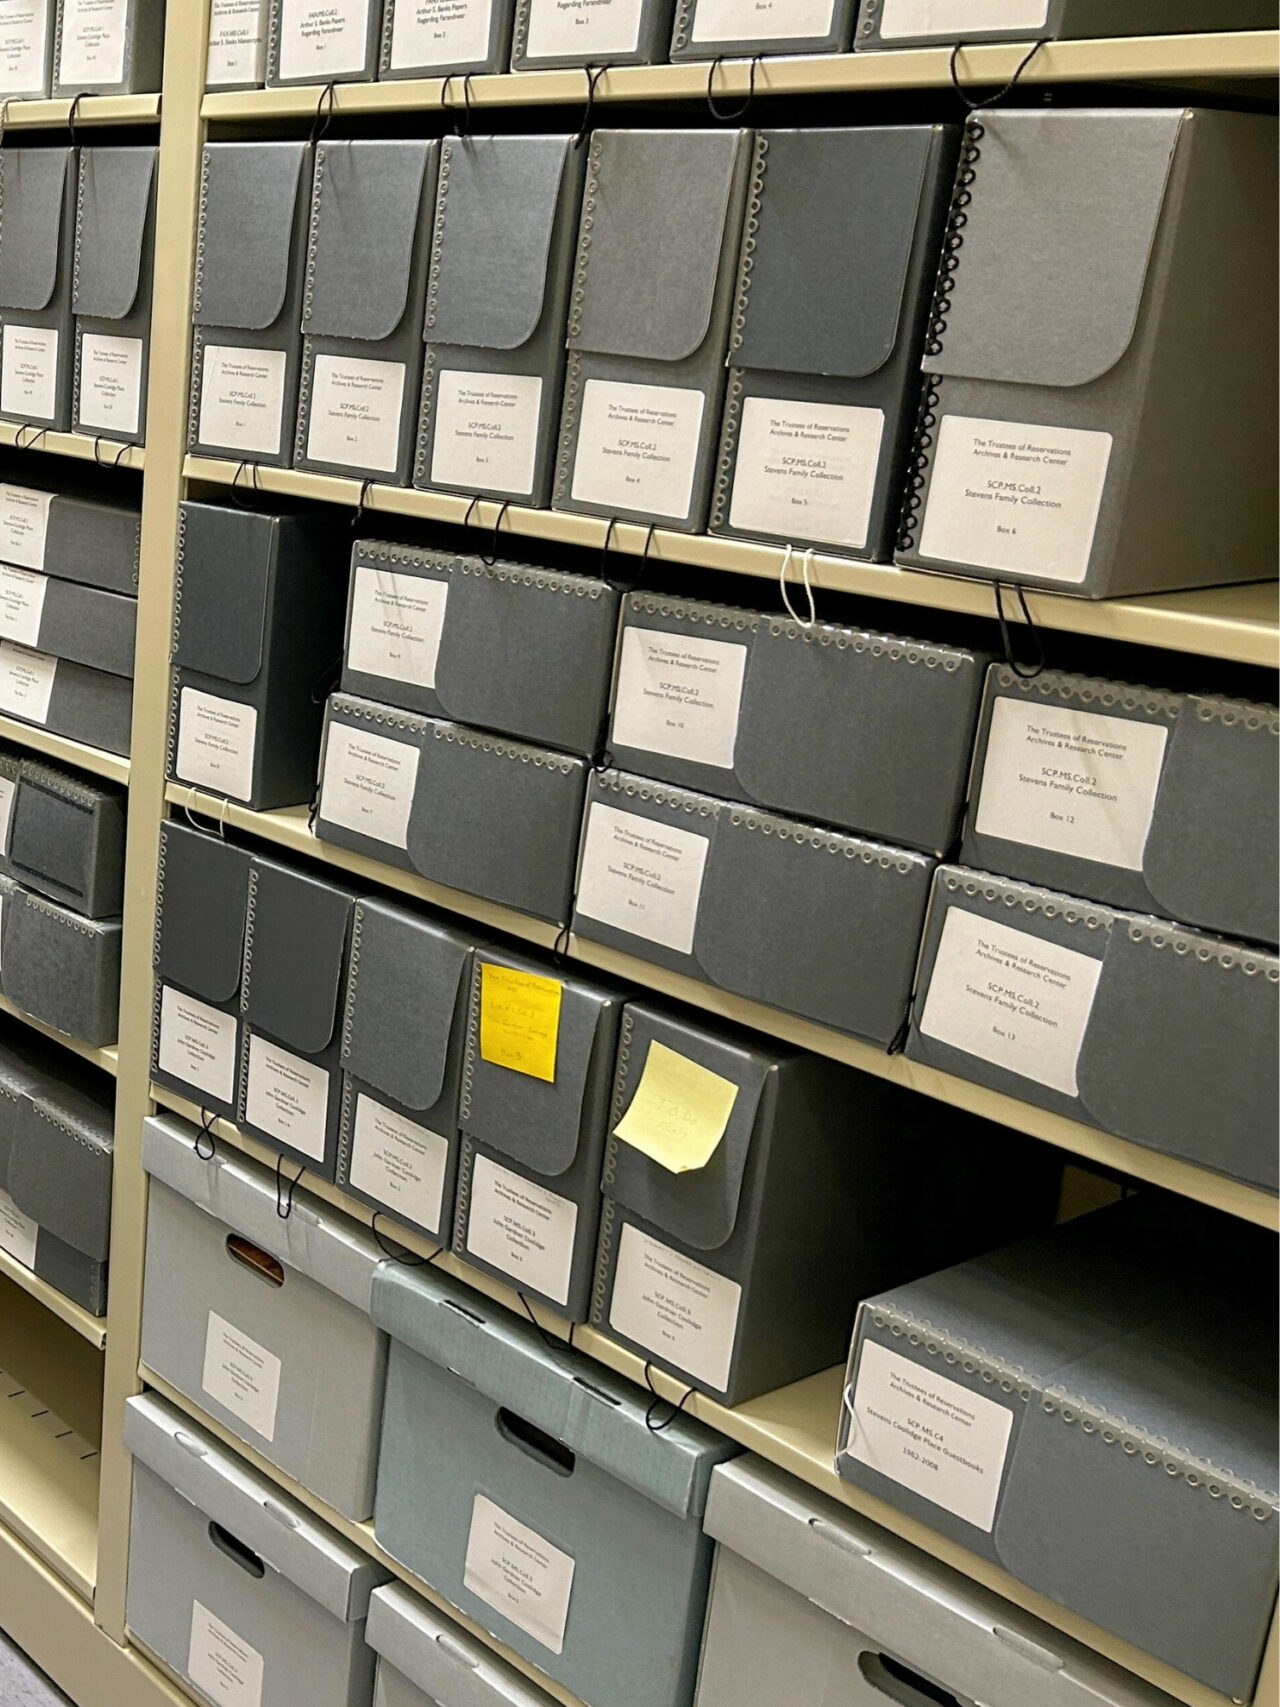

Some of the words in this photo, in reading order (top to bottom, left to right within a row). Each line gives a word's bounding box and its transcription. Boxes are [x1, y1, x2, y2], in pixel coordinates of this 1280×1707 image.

[769, 428, 793, 437] Archives
[800, 431, 825, 440] Research
[826, 433, 847, 442] Center
[770, 419, 781, 427] The
[781, 420, 805, 429] Trustees
[813, 423, 850, 433] Reservations
[972, 448, 1001, 458] Archives
[1009, 452, 1041, 462] Research
[1042, 455, 1068, 465] Center
[973, 438, 986, 447] The
[988, 439, 1016, 450] Trustees
[1026, 444, 1071, 456] Reservations
[782, 456, 826, 469] SCP.MS.Coll.2
[764, 465, 787, 475] Stevens
[788, 467, 808, 478] Family
[809, 470, 843, 481] Collection
[987, 480, 1041, 495] SCP.MS.Coll.2
[791, 497, 802, 505] Box
[964, 488, 993, 500] Stevens
[994, 492, 1019, 504] Family
[1020, 495, 1061, 508] Collection
[996, 525, 1010, 534] Box
[1025, 735, 1055, 747] Archives
[1064, 742, 1096, 754] Research
[1097, 748, 1123, 759] Center
[1027, 724, 1040, 734] The
[1041, 727, 1071, 740] Trustees
[1081, 735, 1126, 751] Reservations
[1041, 767, 1097, 786] SCP.MS.Coll.2
[1018, 773, 1047, 787] Stevens
[1049, 780, 1074, 794] Family
[1075, 785, 1117, 801] Collection
[1049, 811, 1063, 821] Box
[975, 948, 1003, 964] Archives
[1011, 962, 1041, 979] Research
[1042, 974, 1067, 989] Center
[977, 939, 989, 949] The
[991, 944, 1018, 961] Trustees
[1028, 959, 1070, 981] Reservations
[987, 982, 1039, 1009] SCP.MS.Coll.2
[965, 984, 992, 1001] Stevens
[993, 995, 1017, 1012] Family
[1018, 1006, 1058, 1027] Collection
[992, 1025, 1005, 1036] Box
[889, 1381, 914, 1399] Archives
[922, 1398, 950, 1416] Research
[950, 1412, 971, 1427] Center
[890, 1372, 901, 1382] The
[902, 1378, 927, 1396] Trustees
[936, 1395, 975, 1420] Reservations
[867, 1406, 891, 1425] Stevens
[892, 1420, 922, 1441] Coolidge
[923, 1437, 941, 1451] Place
[942, 1447, 983, 1474] Guestbooks
[902, 1447, 938, 1471] 1962-2008
